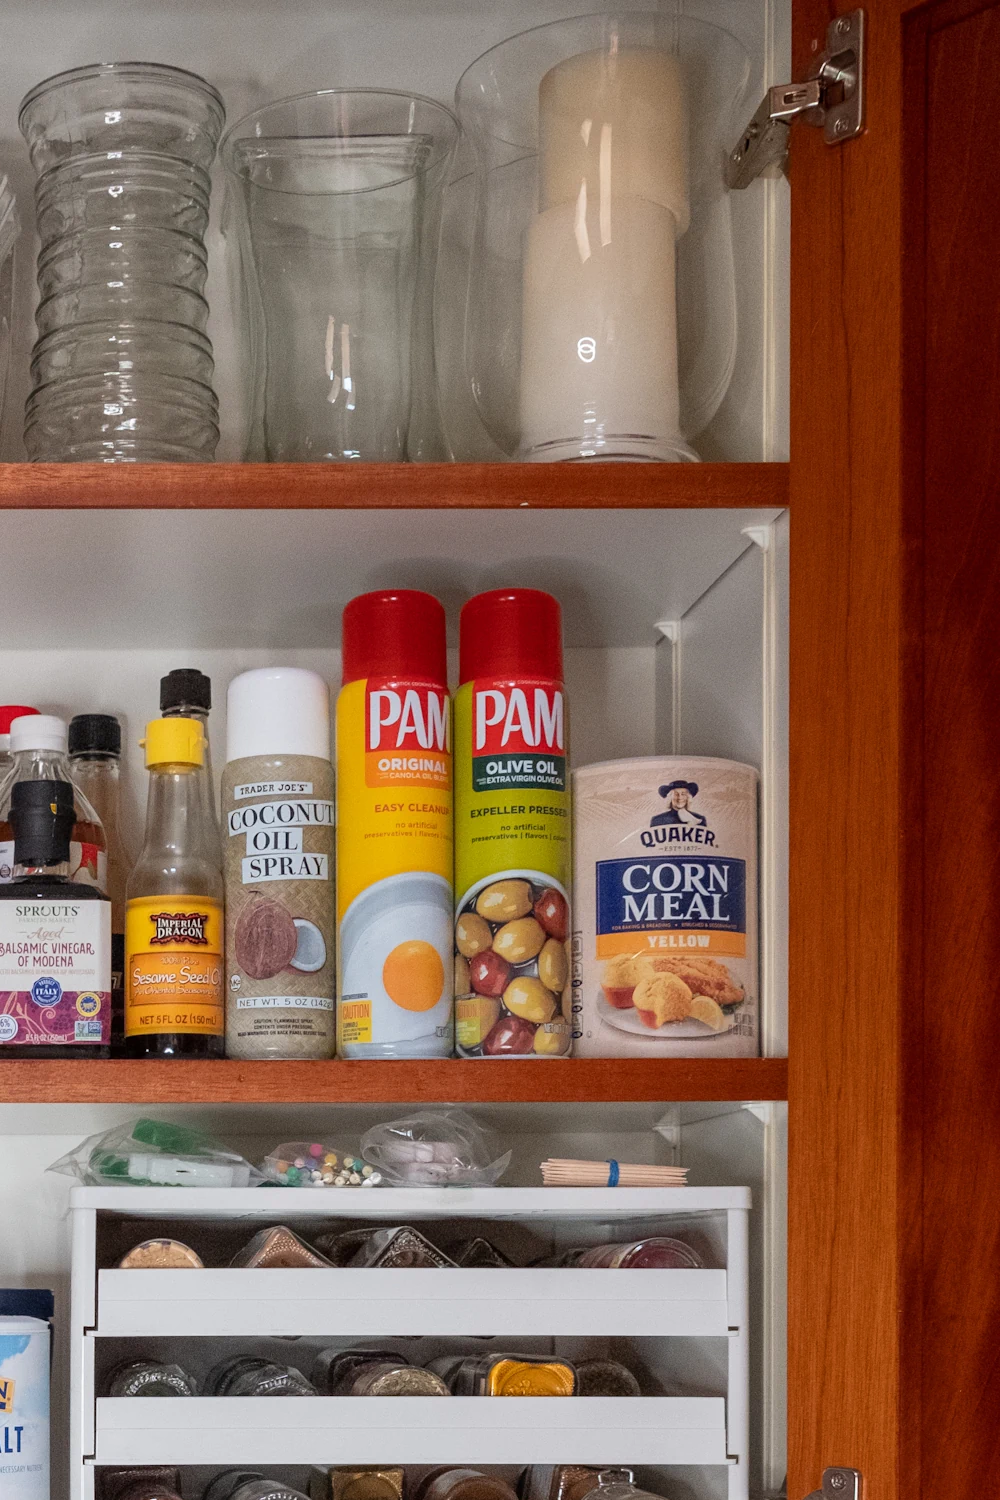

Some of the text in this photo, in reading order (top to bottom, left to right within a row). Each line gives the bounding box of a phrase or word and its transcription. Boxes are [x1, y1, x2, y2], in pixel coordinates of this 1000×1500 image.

[370, 689, 451, 754] PAM
[476, 688, 563, 750] PAM
[378, 758, 447, 774] ORIGINAL
[486, 760, 557, 775] OLIVE OIL
[240, 783, 305, 795] TRADER JOE'S
[375, 803, 404, 813] EASY
[471, 805, 567, 818] EXPELLER PRESSED
[230, 803, 333, 831] COCONUT
[408, 822, 438, 830] artificial
[514, 823, 545, 831] artificial
[253, 831, 298, 850] OIL
[364, 831, 413, 840] preservatives
[472, 832, 548, 843] preservatives flavors
[640, 827, 716, 848] QUAKER
[250, 856, 324, 878] SPRAY
[622, 863, 729, 896] CORN
[15, 905, 79, 917] SPROUTS
[622, 893, 729, 922] MEAL
[157, 918, 202, 928] IMPERIAL
[26, 926, 65, 941] Aged
[157, 927, 202, 939] DRAGON
[648, 935, 710, 948] YELLOW
[51, 942, 95, 955] VINEGAR
[18, 955, 74, 967] OF MODENA
[133, 968, 176, 986] Sesame
[179, 965, 209, 984] Seed
[239, 999, 258, 1007] NET
[262, 998, 279, 1006] WT.
[295, 998, 307, 1006] OZ
[311, 999, 332, 1009] (142g)
[0, 1019, 10, 1027] 6%
[140, 1014, 217, 1025] NET 5 FL OZ (150mL)
